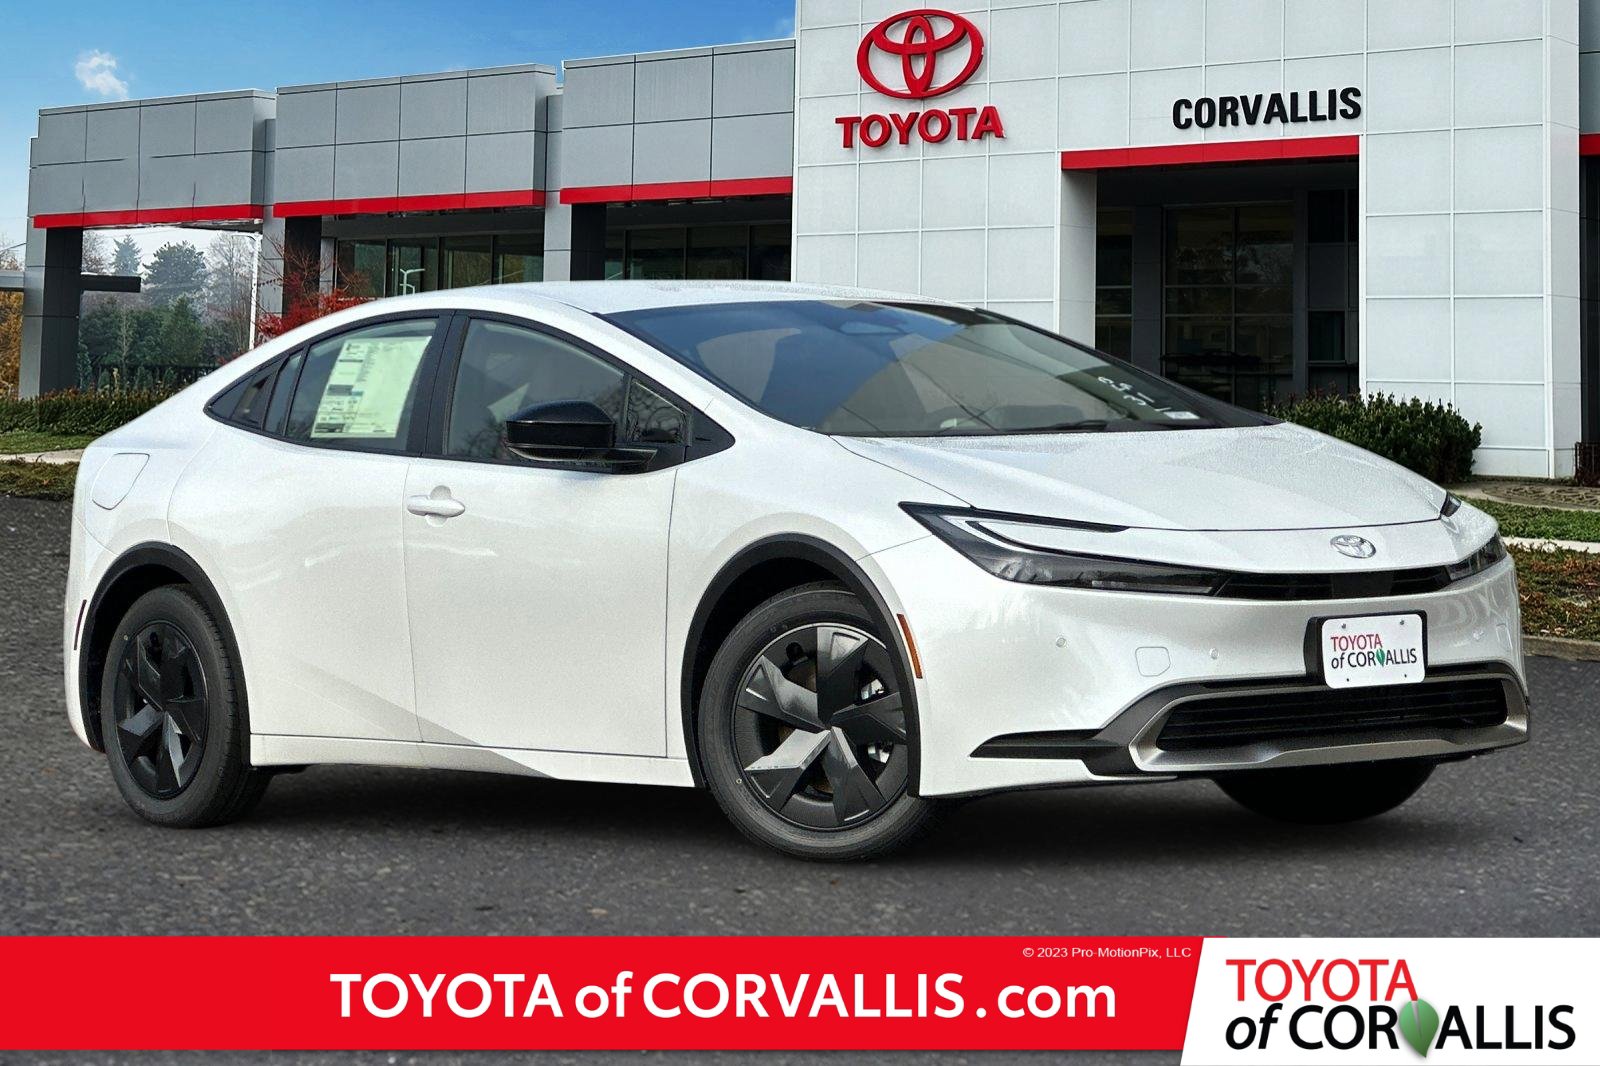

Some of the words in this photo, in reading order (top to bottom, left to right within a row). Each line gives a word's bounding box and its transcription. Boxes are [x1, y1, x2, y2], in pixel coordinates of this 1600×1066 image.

[1172, 87, 1362, 130] CORVALLIS
[836, 106, 1005, 148] TOYOTA
[1330, 633, 1383, 652] TOYOTA
[1331, 652, 1345, 669] of
